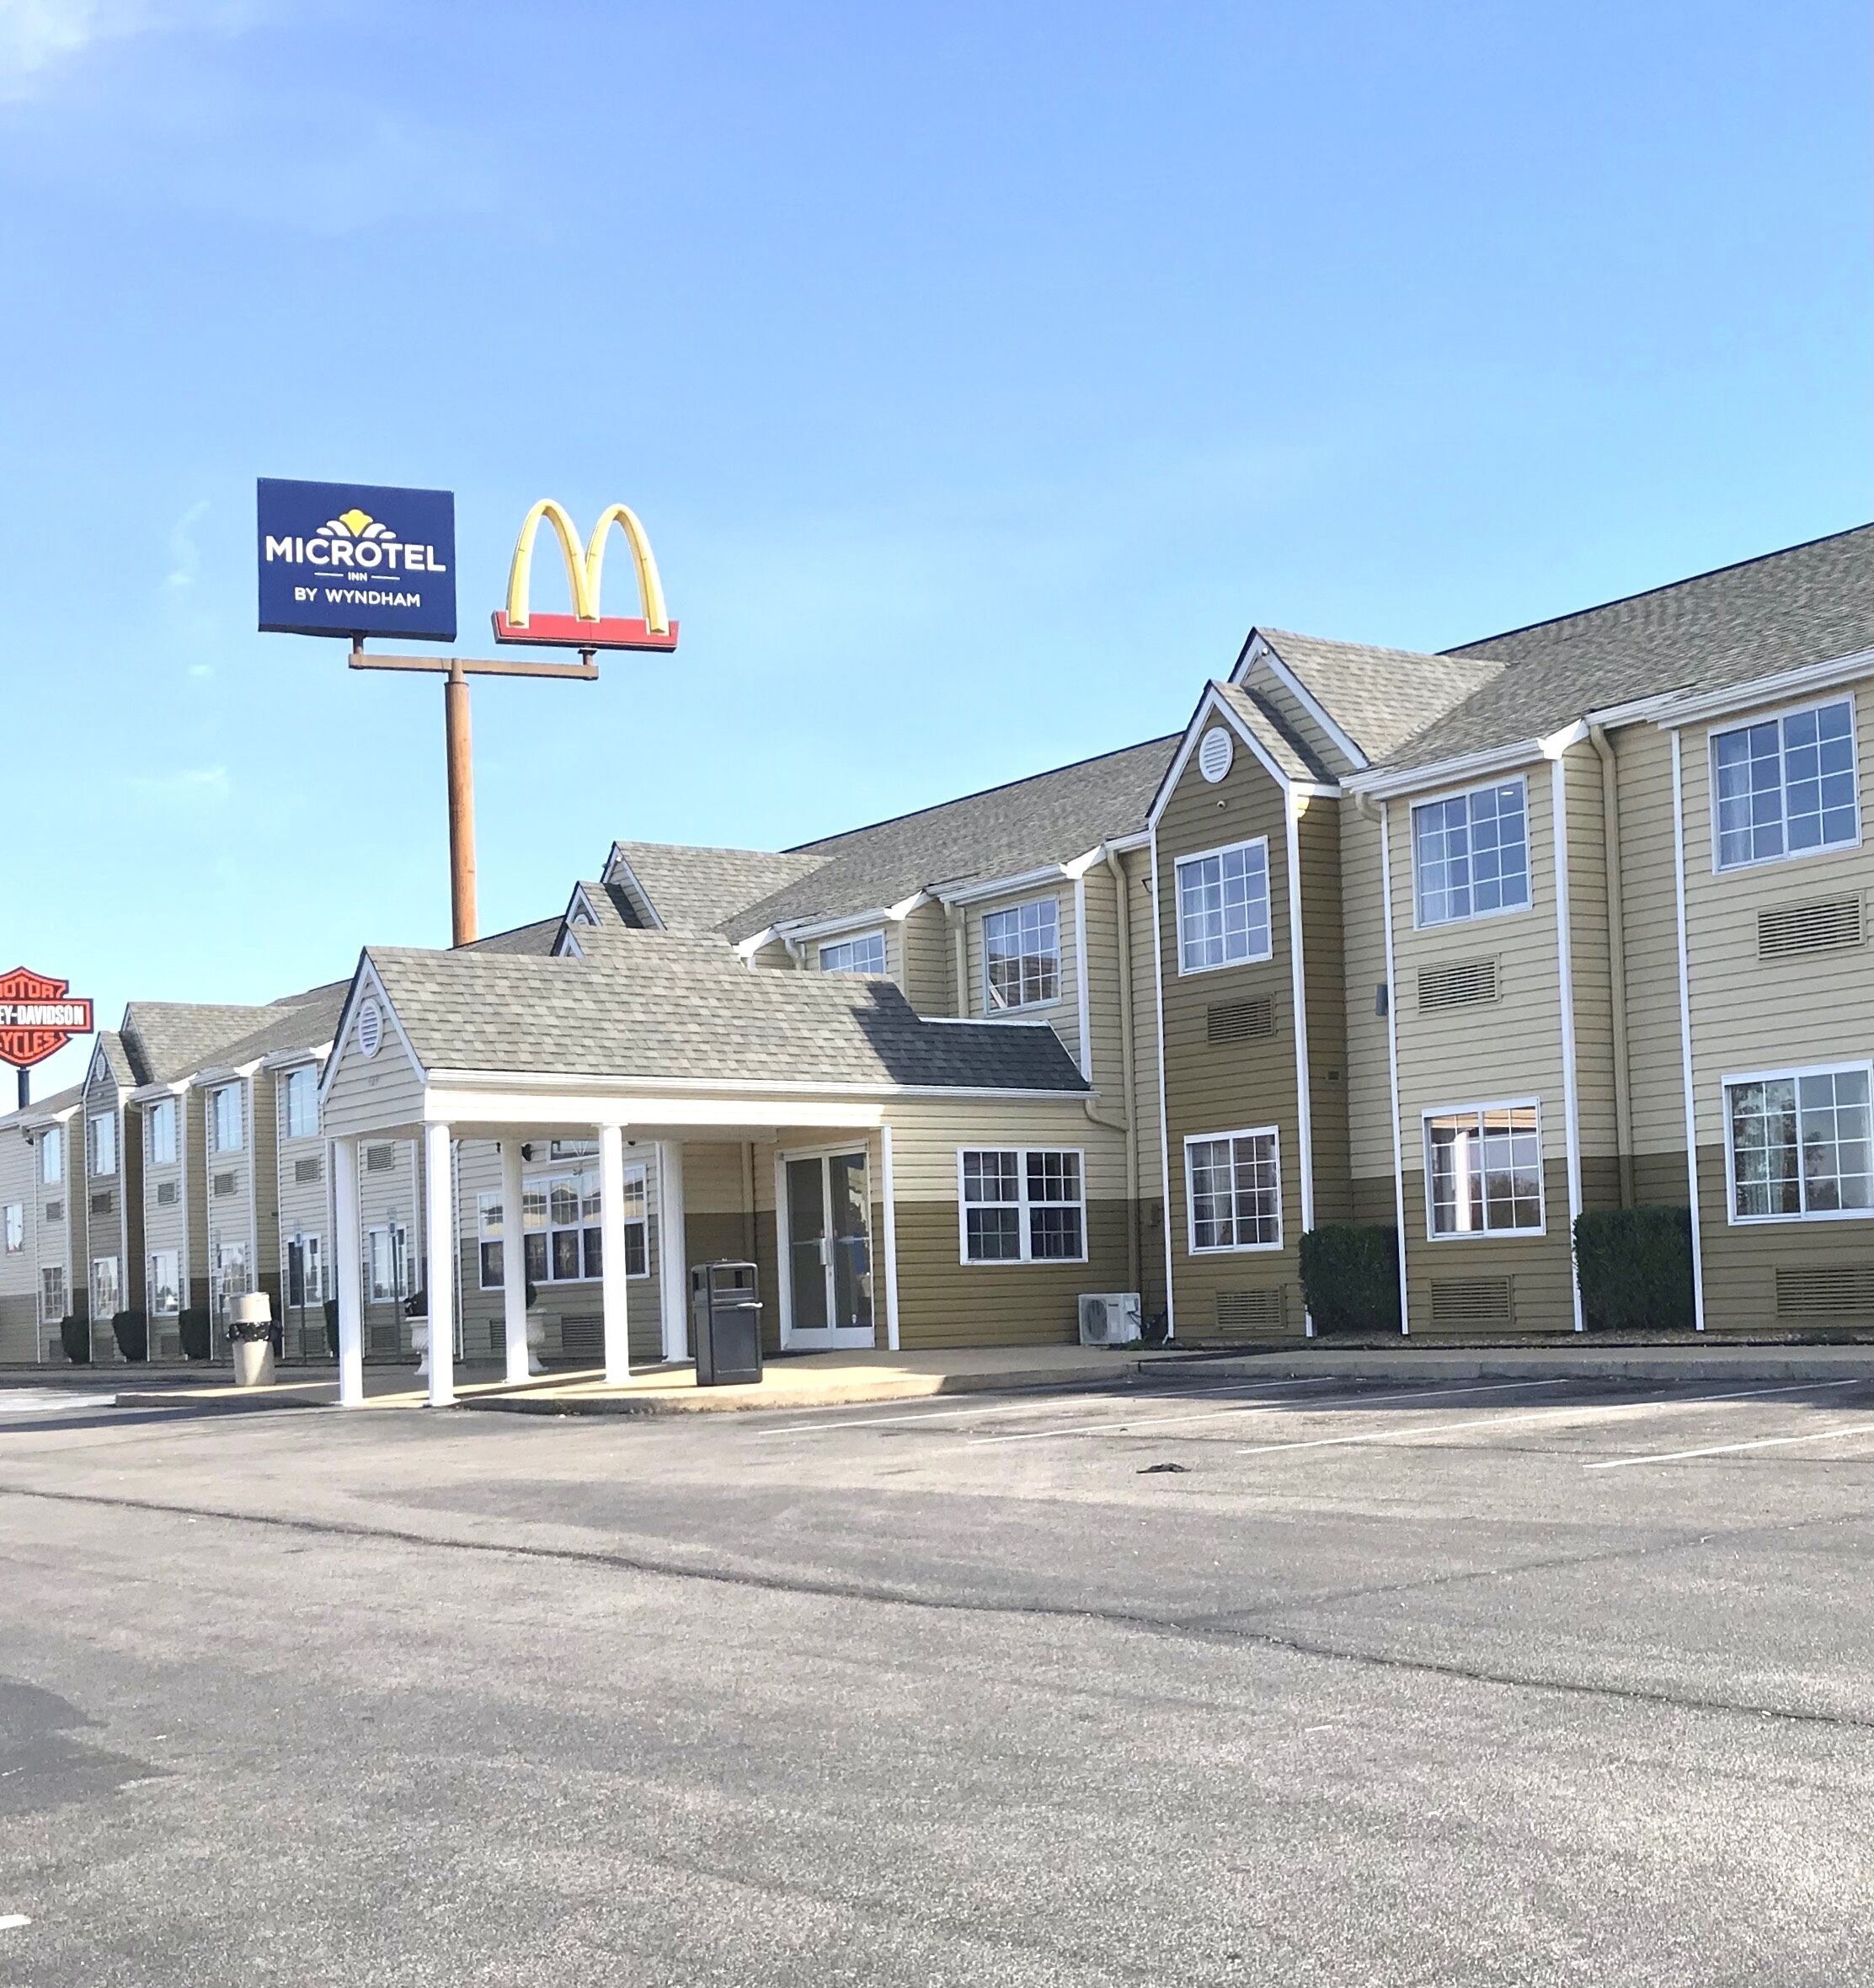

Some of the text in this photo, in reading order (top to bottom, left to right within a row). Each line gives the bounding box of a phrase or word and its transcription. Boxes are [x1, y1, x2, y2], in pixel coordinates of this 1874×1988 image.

[265, 535, 446, 572] MICROTEL
[347, 571, 368, 581] INN
[294, 586, 421, 607] BY WYNDHAM
[0, 1032, 55, 1057] YCLES
